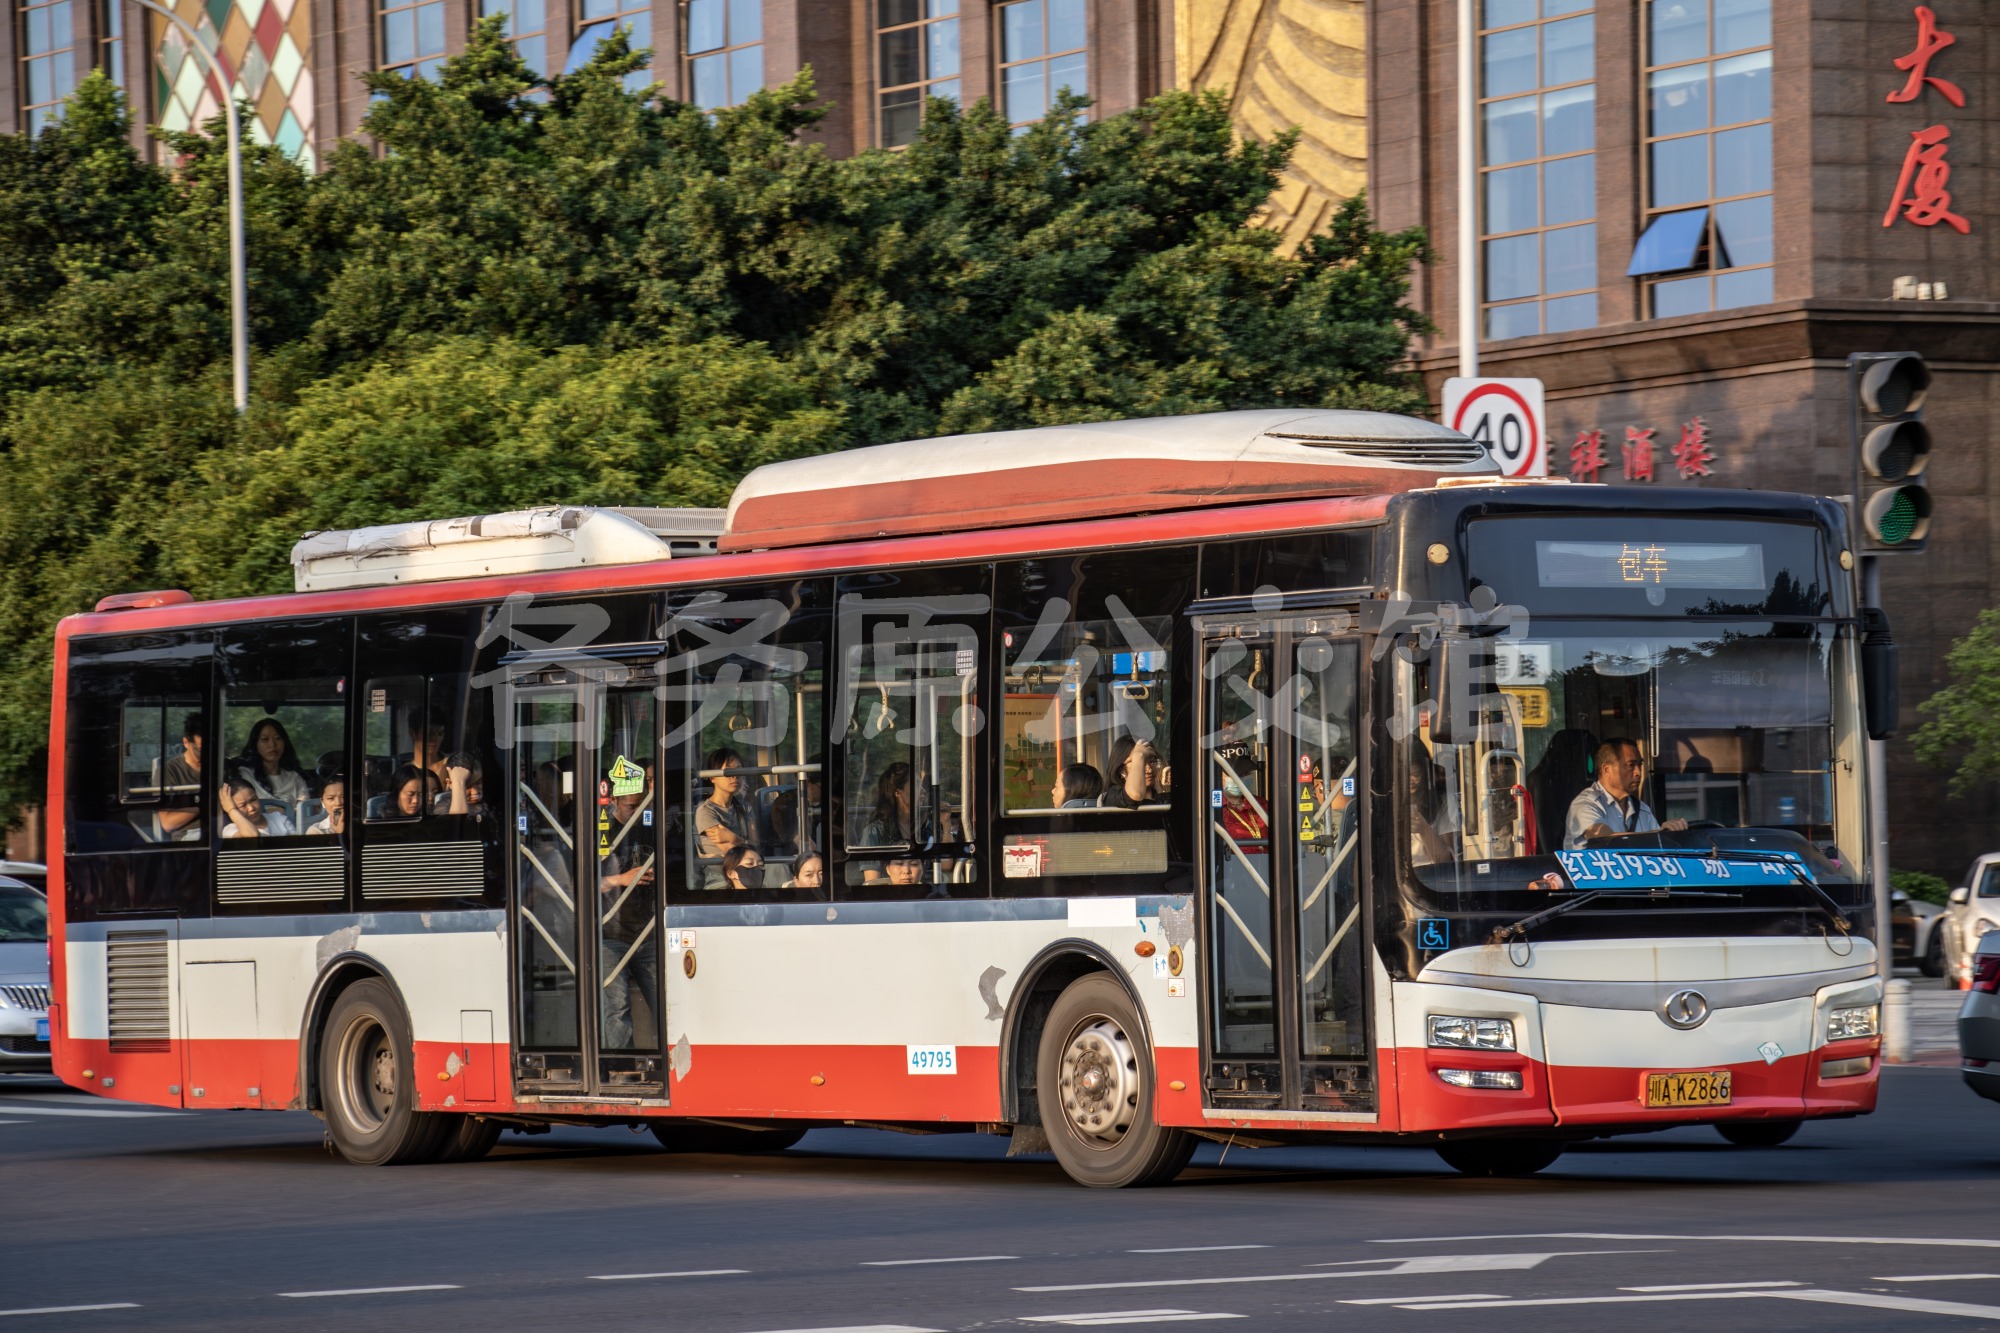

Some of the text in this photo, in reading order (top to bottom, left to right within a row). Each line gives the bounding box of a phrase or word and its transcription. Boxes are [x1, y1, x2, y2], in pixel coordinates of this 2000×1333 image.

[1882, 5, 1972, 234] 大厦
[1471, 412, 1522, 460] 40
[1546, 416, 1717, 484] 祥酒楼
[1617, 543, 1668, 584] 包车
[912, 1051, 952, 1068] 49795
[1763, 1046, 1779, 1057] CNG
